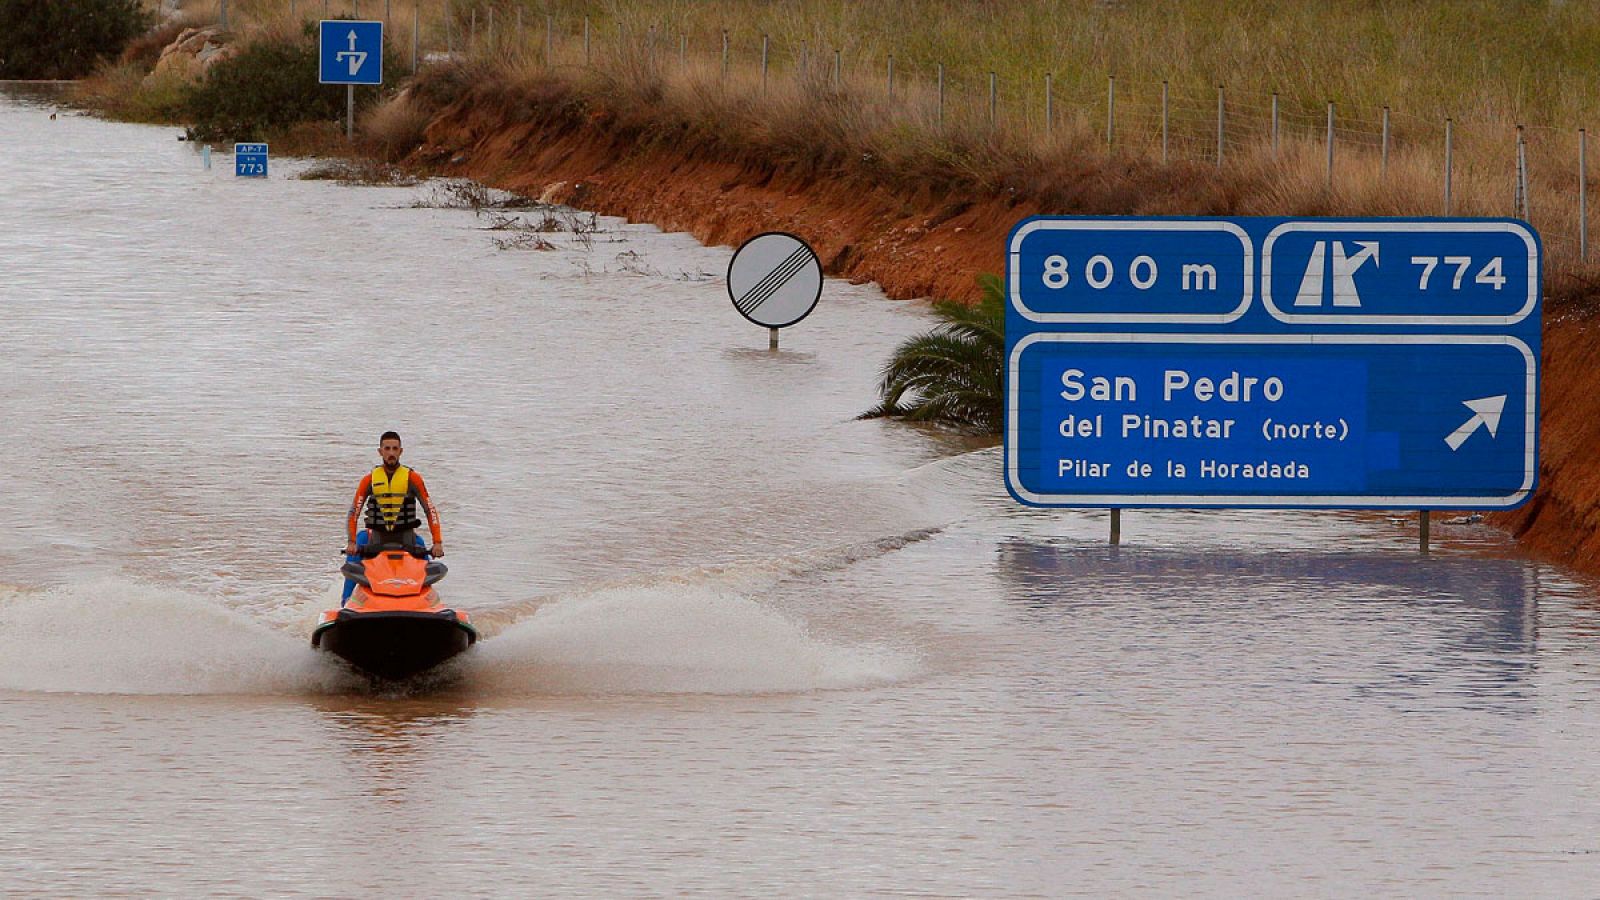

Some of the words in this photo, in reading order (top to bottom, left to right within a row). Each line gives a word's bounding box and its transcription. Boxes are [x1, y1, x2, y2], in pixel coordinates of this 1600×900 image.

[239, 163, 264, 173] 773
[1042, 254, 1158, 290] 800
[1182, 263, 1217, 290] m
[1411, 256, 1506, 290] 774
[1060, 368, 1136, 401] San
[1164, 370, 1284, 402] Pedro
[1059, 414, 1102, 438] del
[1122, 414, 1235, 439] Pinatar
[1262, 418, 1349, 441] (norte)
[1058, 459, 1110, 478] Pilar
[1126, 459, 1153, 478] de
[1167, 460, 1186, 478] la
[1200, 459, 1309, 479] Horadada
